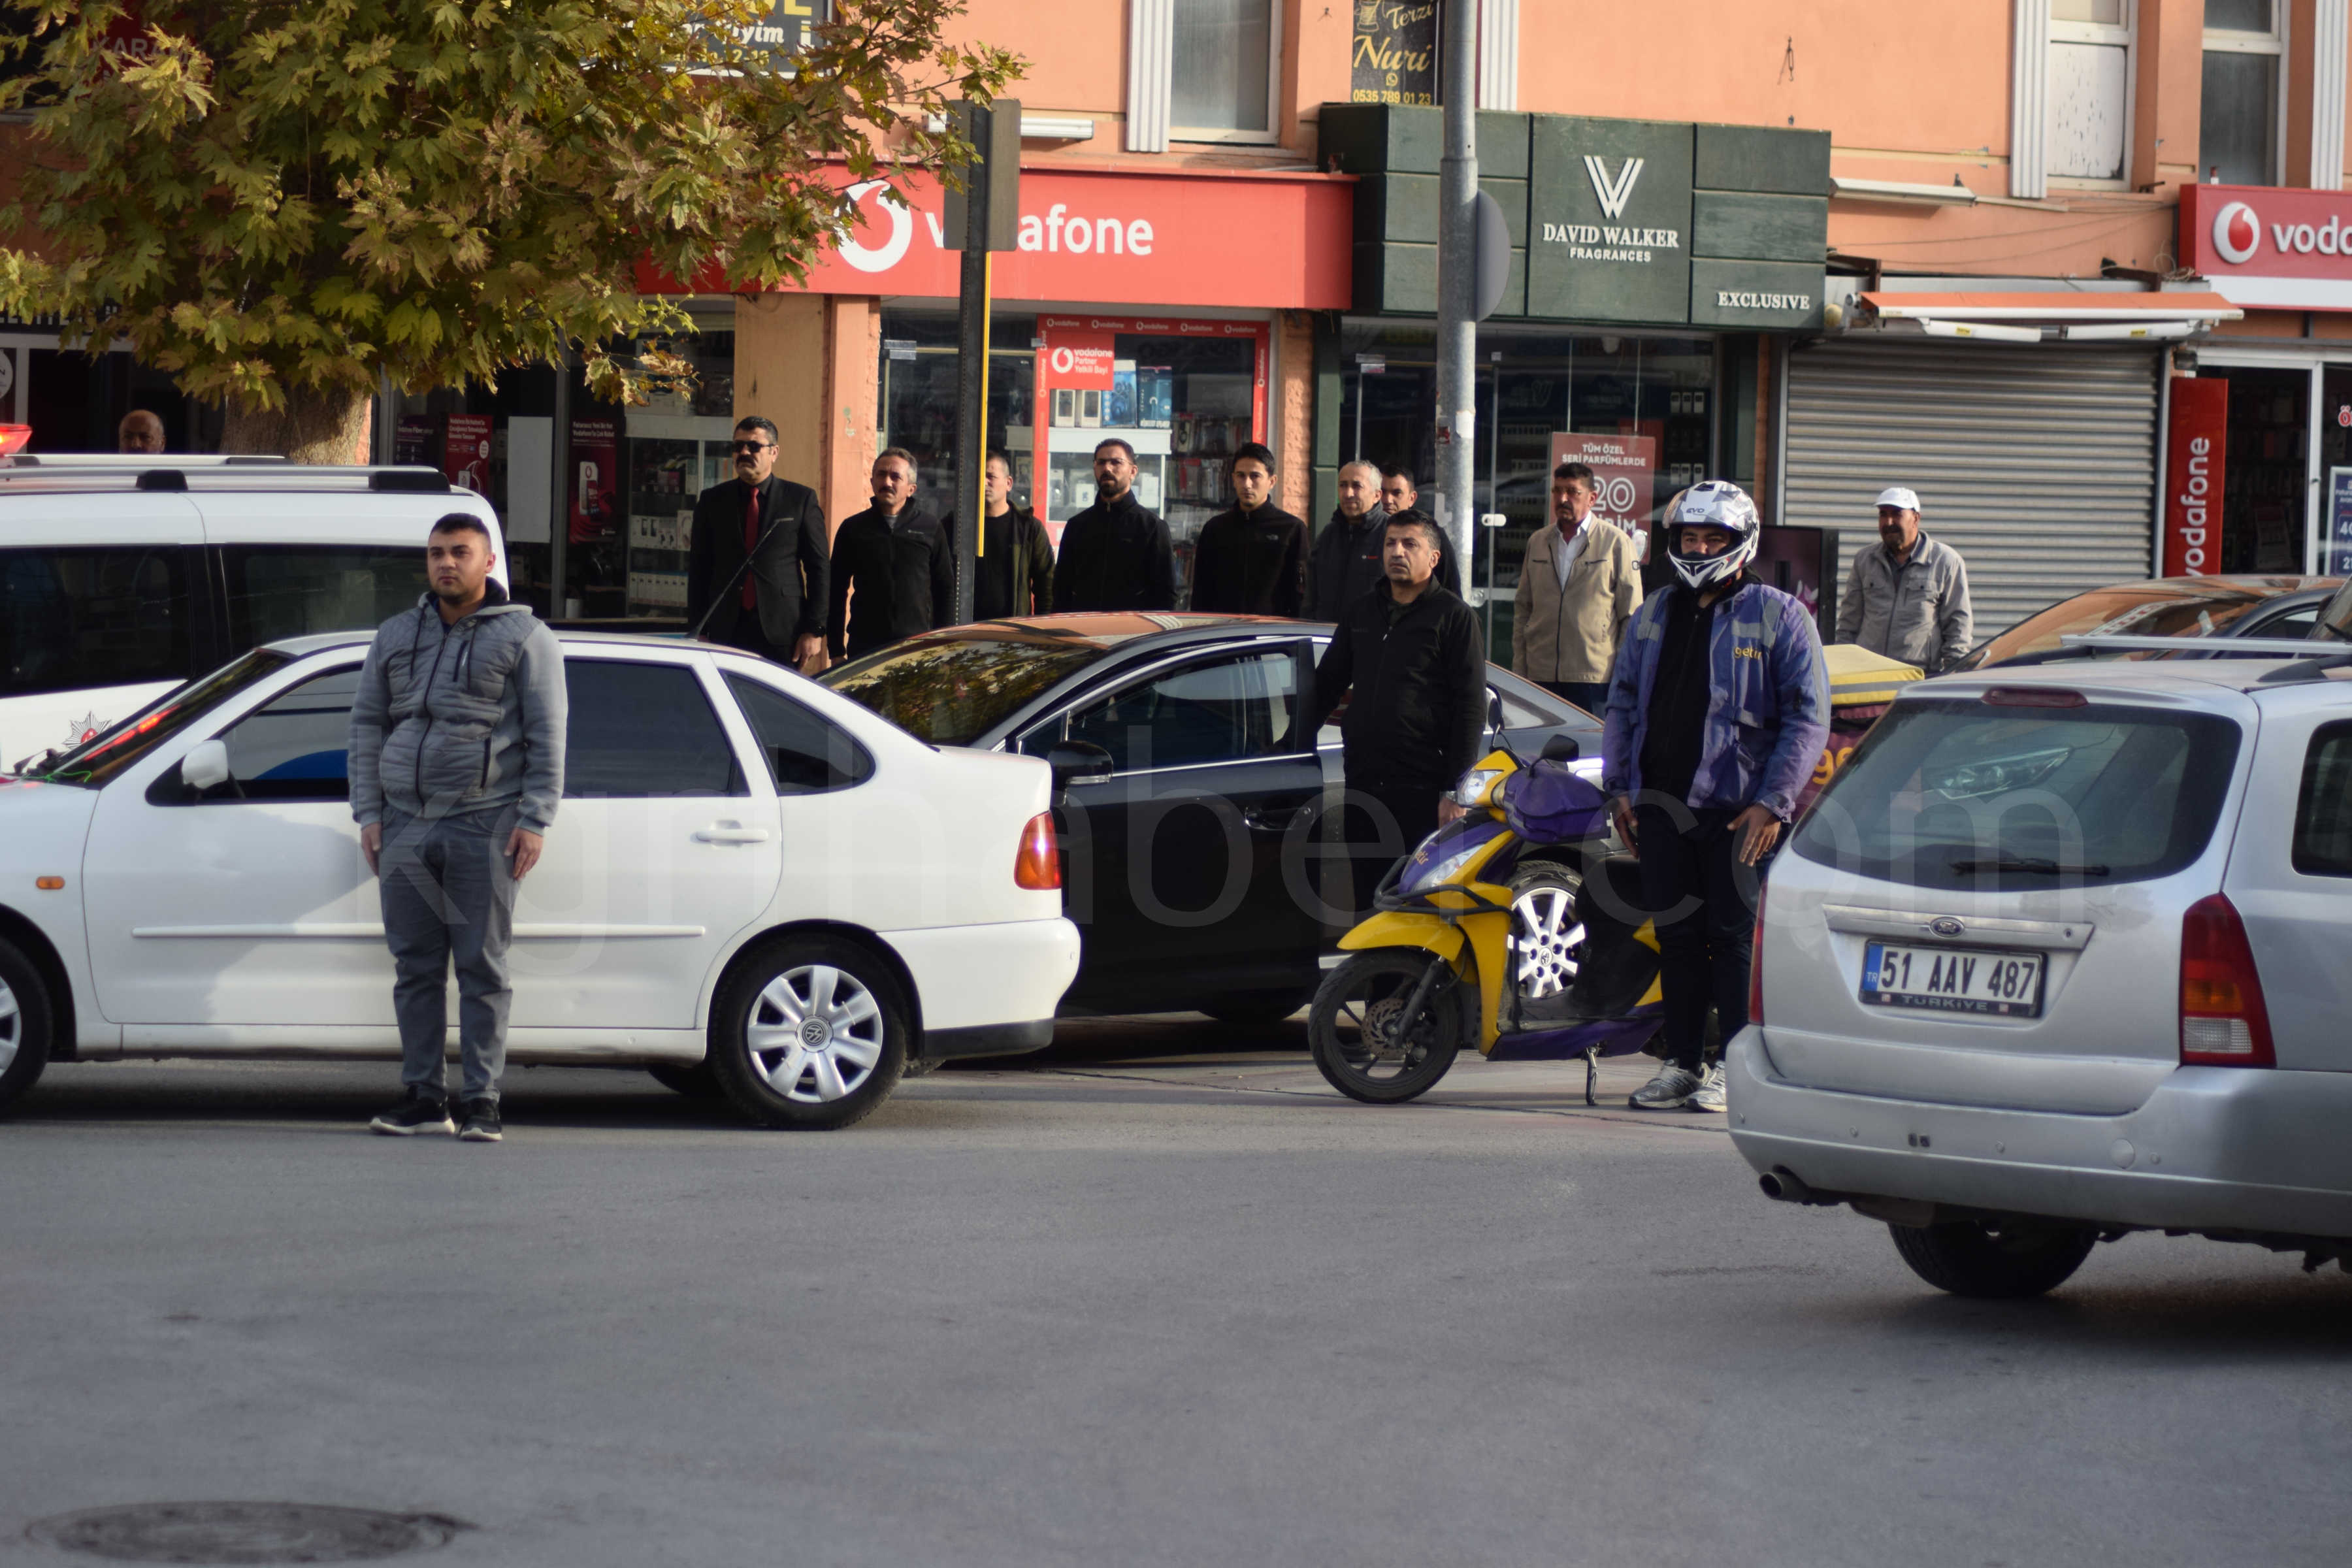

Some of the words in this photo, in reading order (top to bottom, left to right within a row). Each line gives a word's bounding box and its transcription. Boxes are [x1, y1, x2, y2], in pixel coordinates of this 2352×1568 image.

[1386, 0, 1434, 30] Terzi
[1353, 35, 1432, 72] Nuri
[1353, 89, 1379, 103] 0535
[1381, 90, 1401, 104] 789
[1403, 91, 1415, 105] 01
[1418, 92, 1431, 105] 23
[926, 203, 1154, 255] vafone
[1543, 223, 1600, 244] DAVID
[1603, 227, 1679, 248] WALKER
[1569, 247, 1651, 263] FRAGRANCES
[1717, 291, 1810, 310] EXCLUSIVE
[1074, 348, 1113, 357] vodafone
[1582, 442, 1600, 453] TÜM
[1603, 443, 1625, 454] ÖZEL
[1562, 453, 1582, 463] SERİ
[1583, 455, 1646, 466] PARFÜMLERDE
[1867, 972, 1878, 982] TR
[1882, 951, 1912, 989] 51
[1927, 955, 1976, 994] AAV
[1987, 960, 2035, 999] 487
